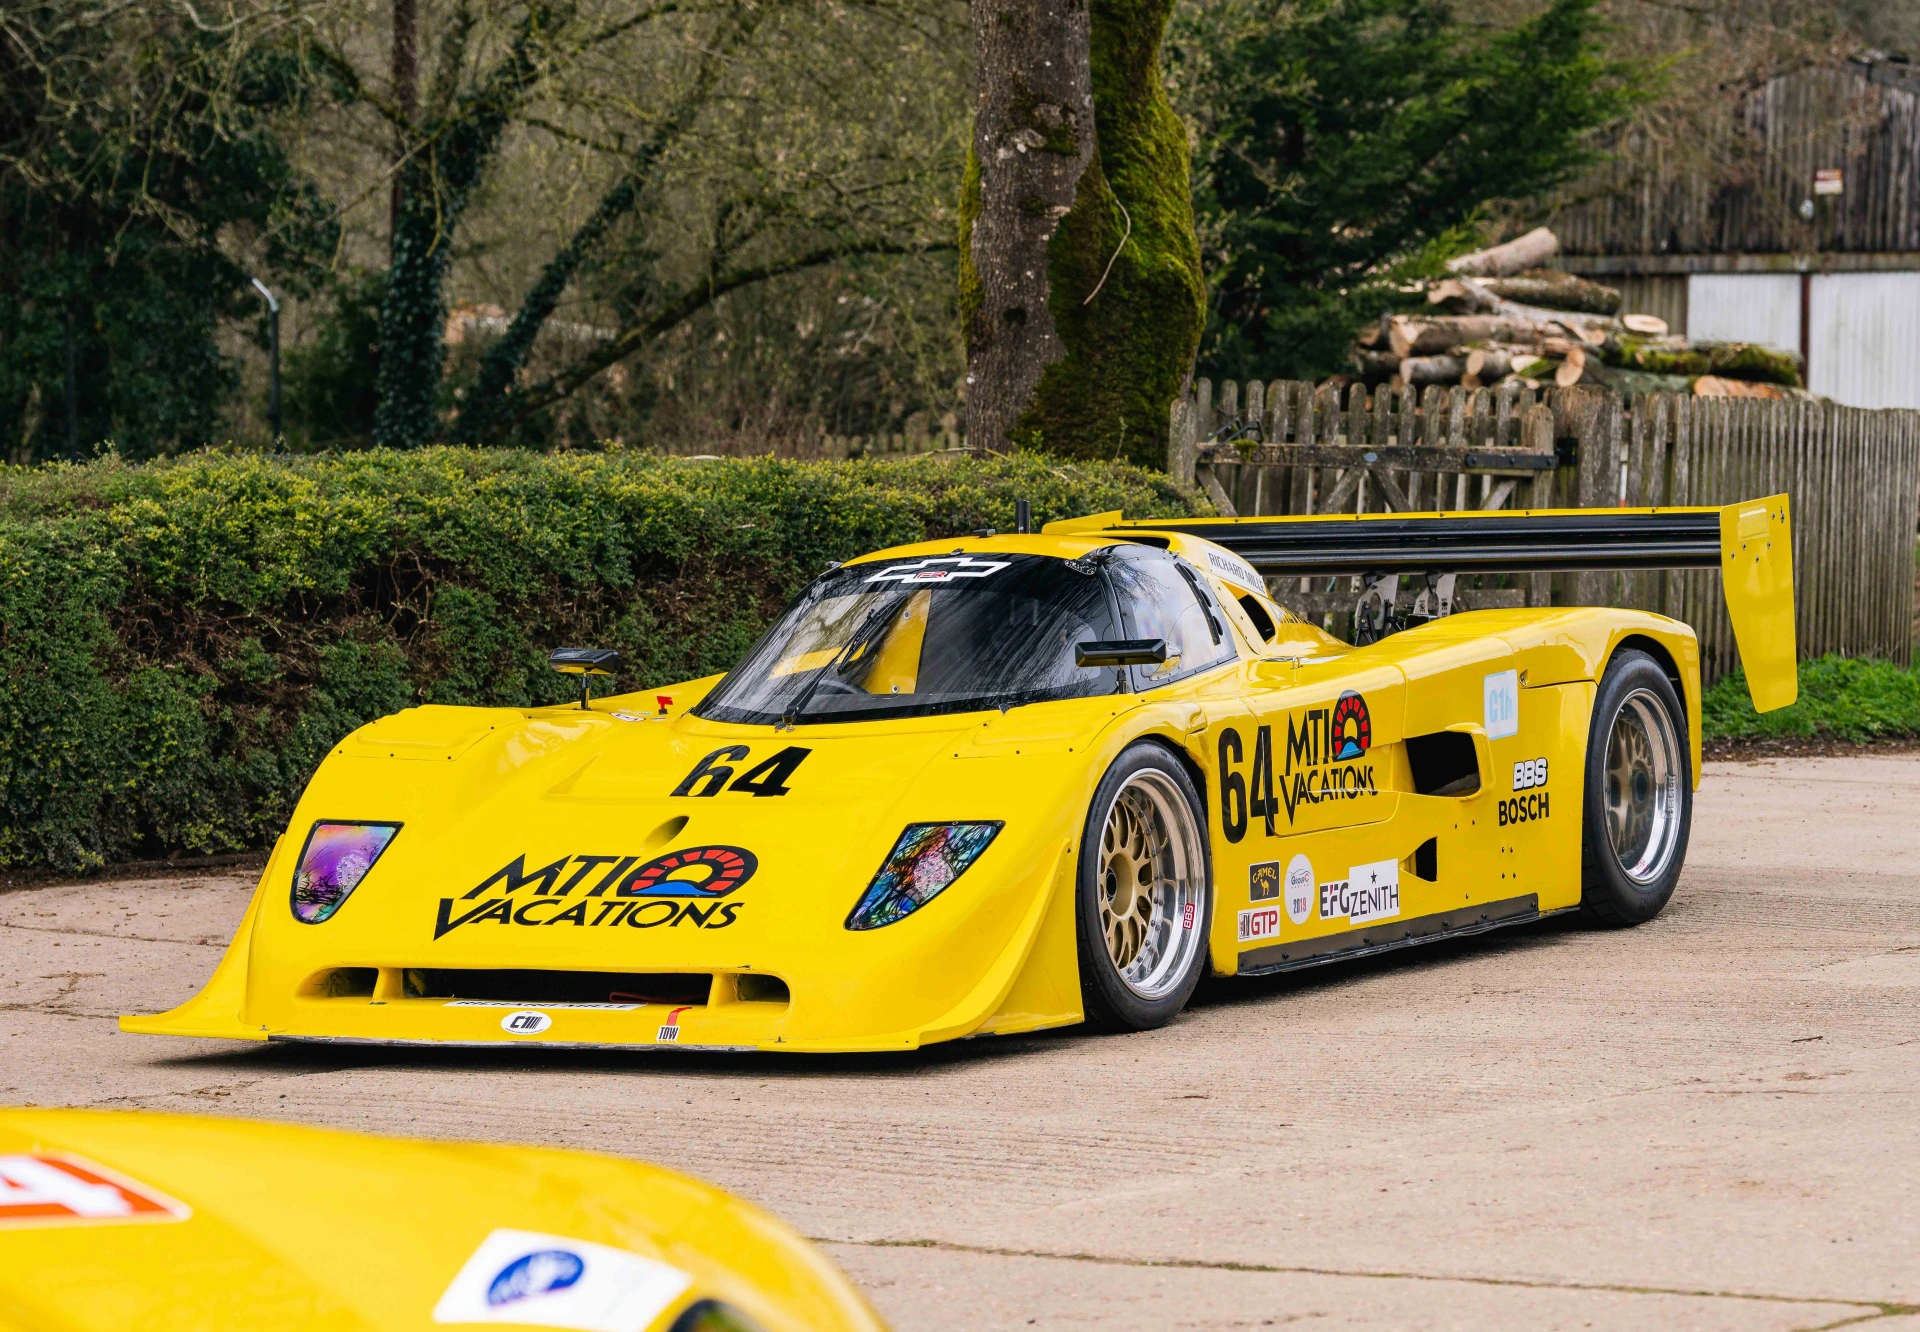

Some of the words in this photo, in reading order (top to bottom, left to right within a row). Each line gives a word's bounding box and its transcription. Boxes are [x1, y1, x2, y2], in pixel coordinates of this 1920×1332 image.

[1208, 552, 1245, 580] RICHARD
[1244, 570, 1266, 594] MILLE
[1286, 709, 1330, 776] MTI
[669, 745, 813, 797] 64
[1218, 725, 1278, 844] 64
[1512, 757, 1548, 792] BBS
[1279, 765, 1379, 827] VACATIONS
[1498, 792, 1550, 827] BOSCH
[460, 853, 641, 899] MTI
[1252, 867, 1277, 883] CAMEL
[1183, 904, 1195, 928] BBS
[1293, 897, 1307, 914] 2019
[1320, 882, 1350, 917] EFG
[1350, 884, 1399, 917] ZENITH
[433, 898, 744, 941] VACATIONS
[1251, 910, 1278, 936] GTP
[659, 1026, 679, 1040] TOW
